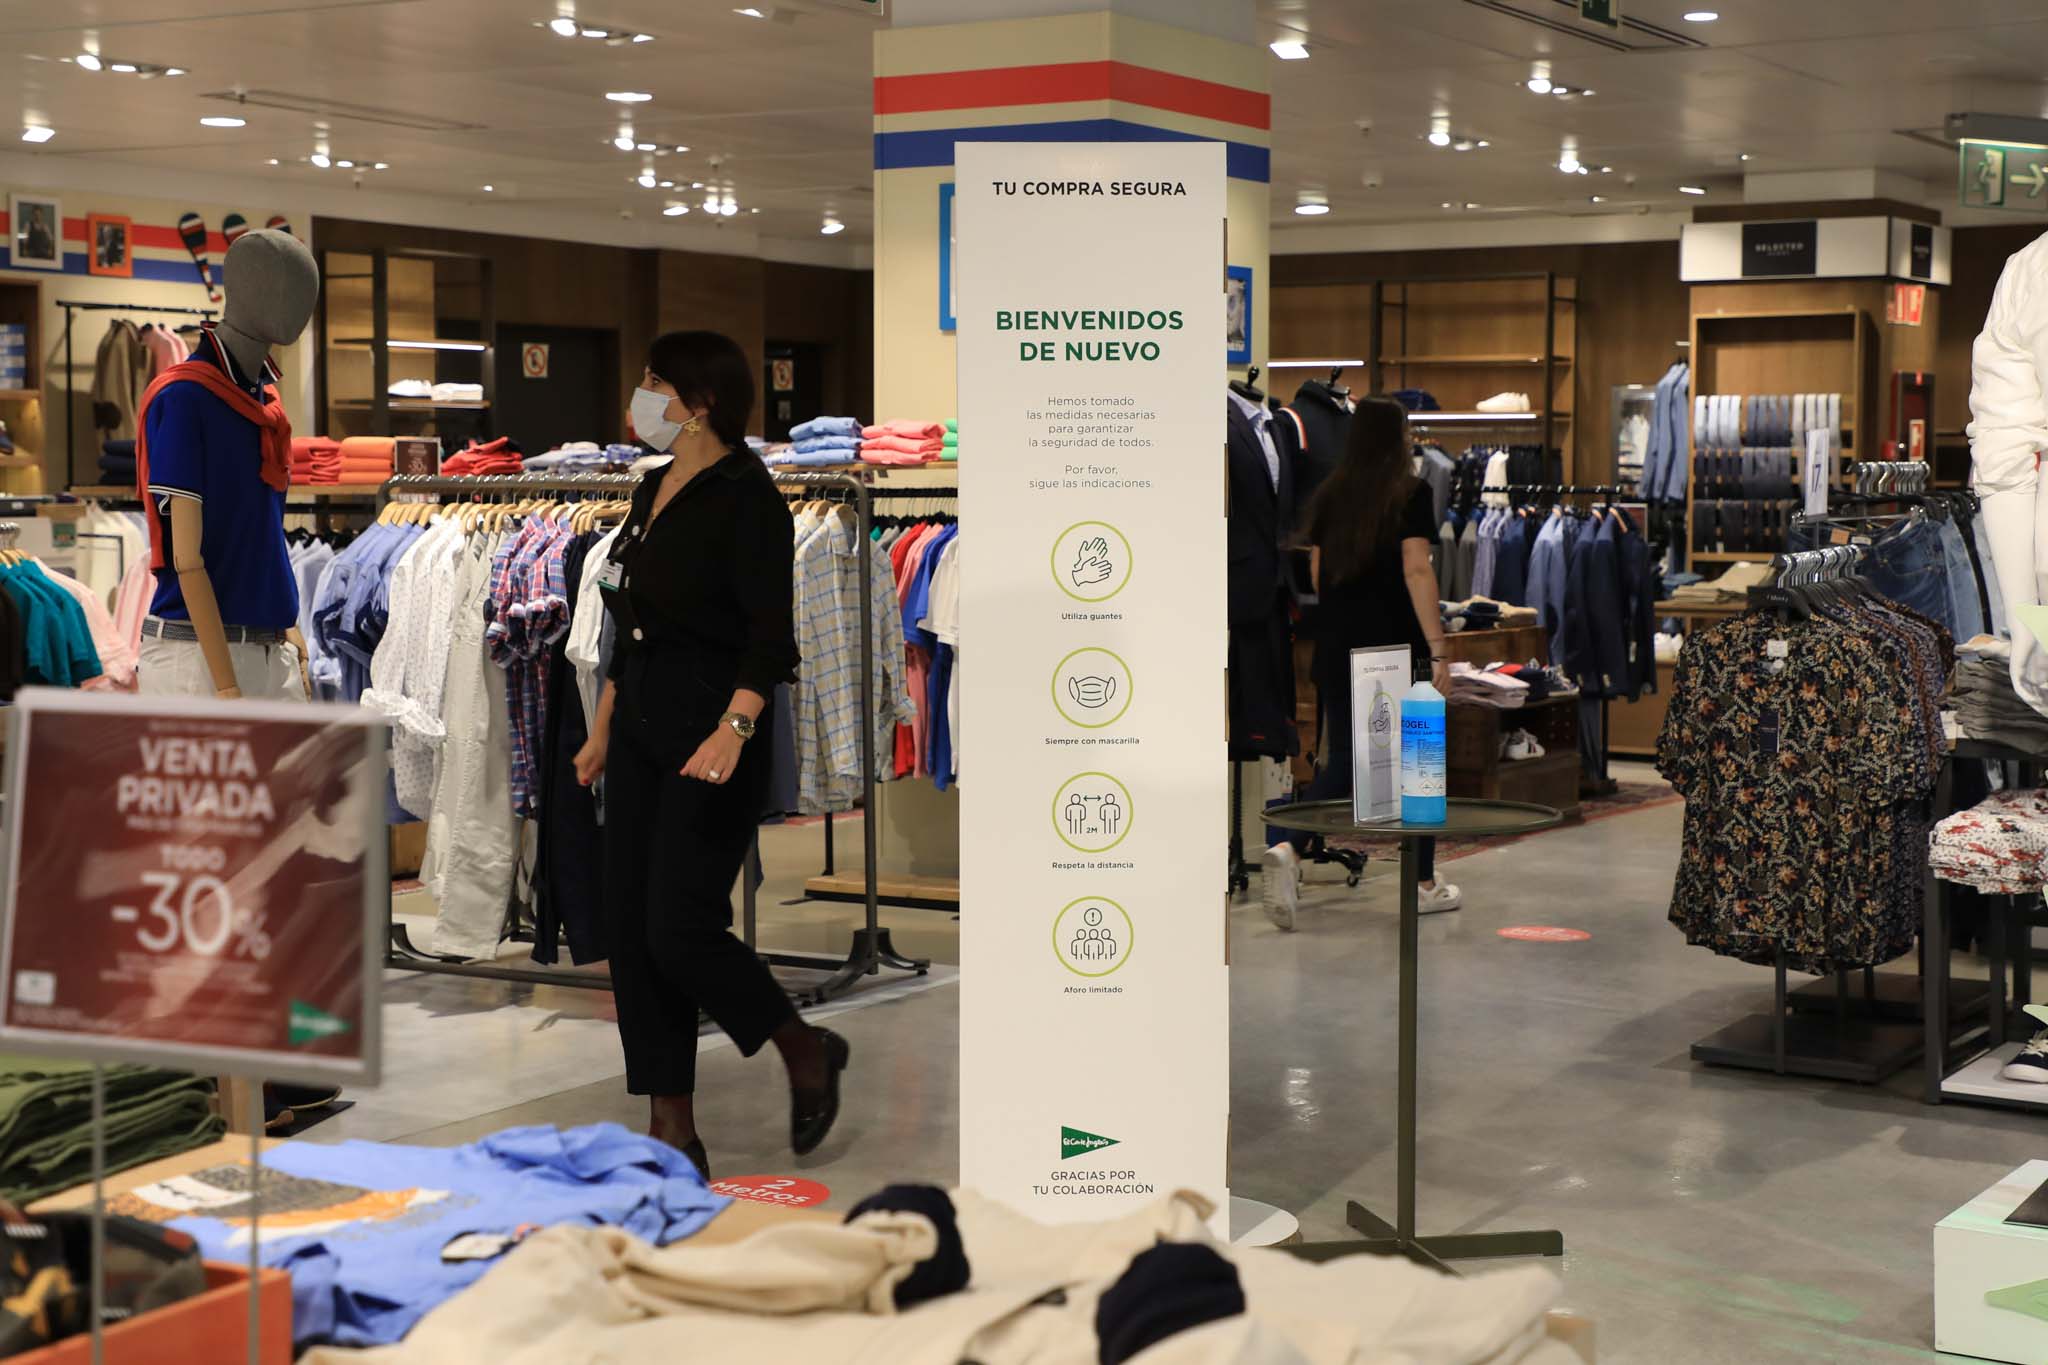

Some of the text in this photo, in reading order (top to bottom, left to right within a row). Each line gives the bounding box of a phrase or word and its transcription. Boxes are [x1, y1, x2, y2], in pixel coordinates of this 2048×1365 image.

[992, 181, 1187, 196] TU COMPRA SEGURA
[996, 310, 1184, 330] BIENVENIDOS
[1020, 341, 1160, 361] DE NUEVO
[1048, 396, 1135, 406] Hemos tomado
[1026, 409, 1156, 420] las medidas necesarias
[1048, 423, 1134, 435] para garantizar
[1028, 437, 1154, 448] la seguridad de todos.
[1065, 464, 1118, 475] Por favor,
[1029, 480, 1060, 490] sigue
[1063, 479, 1078, 488] las
[1061, 612, 1123, 621] Utiliza guantes
[1045, 737, 1079, 746] Siempre
[1099, 737, 1140, 745] mascarilla
[140, 738, 256, 778] VENTA
[118, 777, 274, 820] PRIVADA
[1086, 826, 1098, 834] 2M
[160, 846, 226, 869] TODO
[1052, 861, 1134, 870] Respeta la distancia
[1063, 985, 1123, 994] Aforo limitado
[1051, 1170, 1136, 1181] GRACIAS POR
[761, 1179, 796, 1190] 2
[1032, 1181, 1154, 1195] TU COLABORACIÓN
[711, 1182, 809, 1203] Metros
